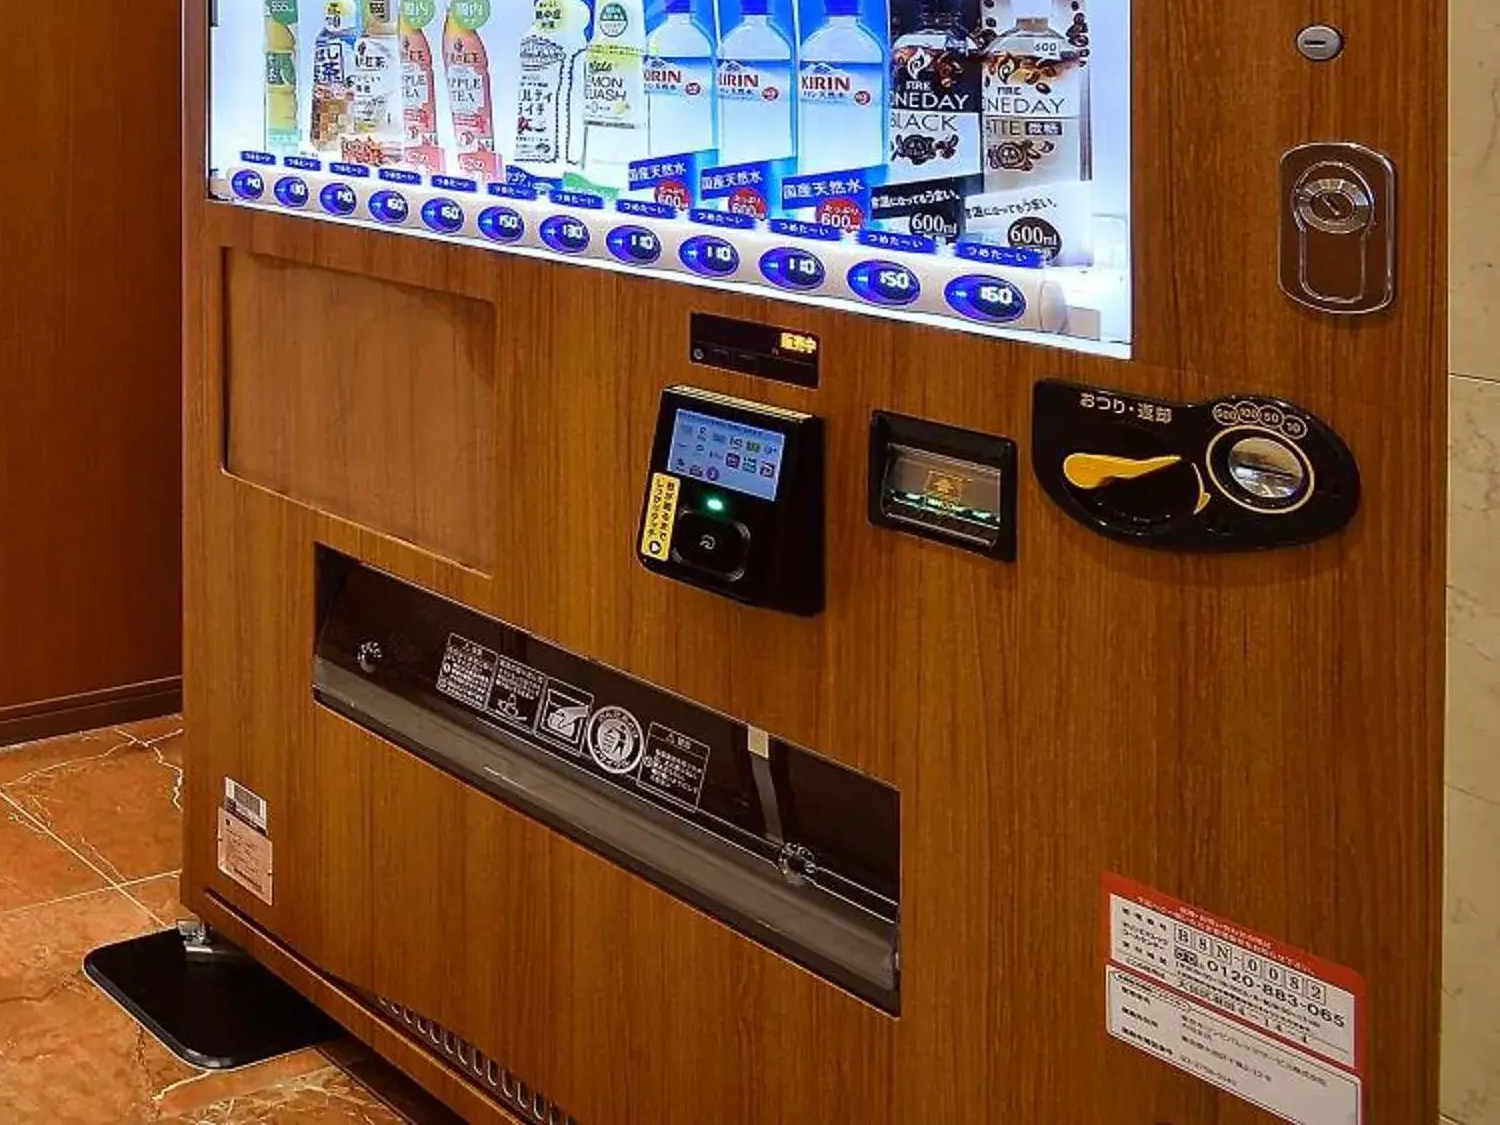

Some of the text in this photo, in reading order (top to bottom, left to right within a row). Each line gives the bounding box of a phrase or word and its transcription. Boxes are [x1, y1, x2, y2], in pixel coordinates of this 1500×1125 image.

[802, 75, 850, 92] KIRIN
[905, 80, 932, 91] FIRE
[701, 170, 763, 190] 国産天然水
[783, 178, 865, 199] 国産天然水
[911, 213, 957, 234] 600ml
[1010, 225, 1057, 245] 600ml
[880, 271, 908, 289] 150
[1080, 392, 1172, 424] おつり・返却
[1263, 411, 1280, 423] 50
[1286, 422, 1301, 434] 10
[1206, 959, 1347, 1028] 0120-883-065
